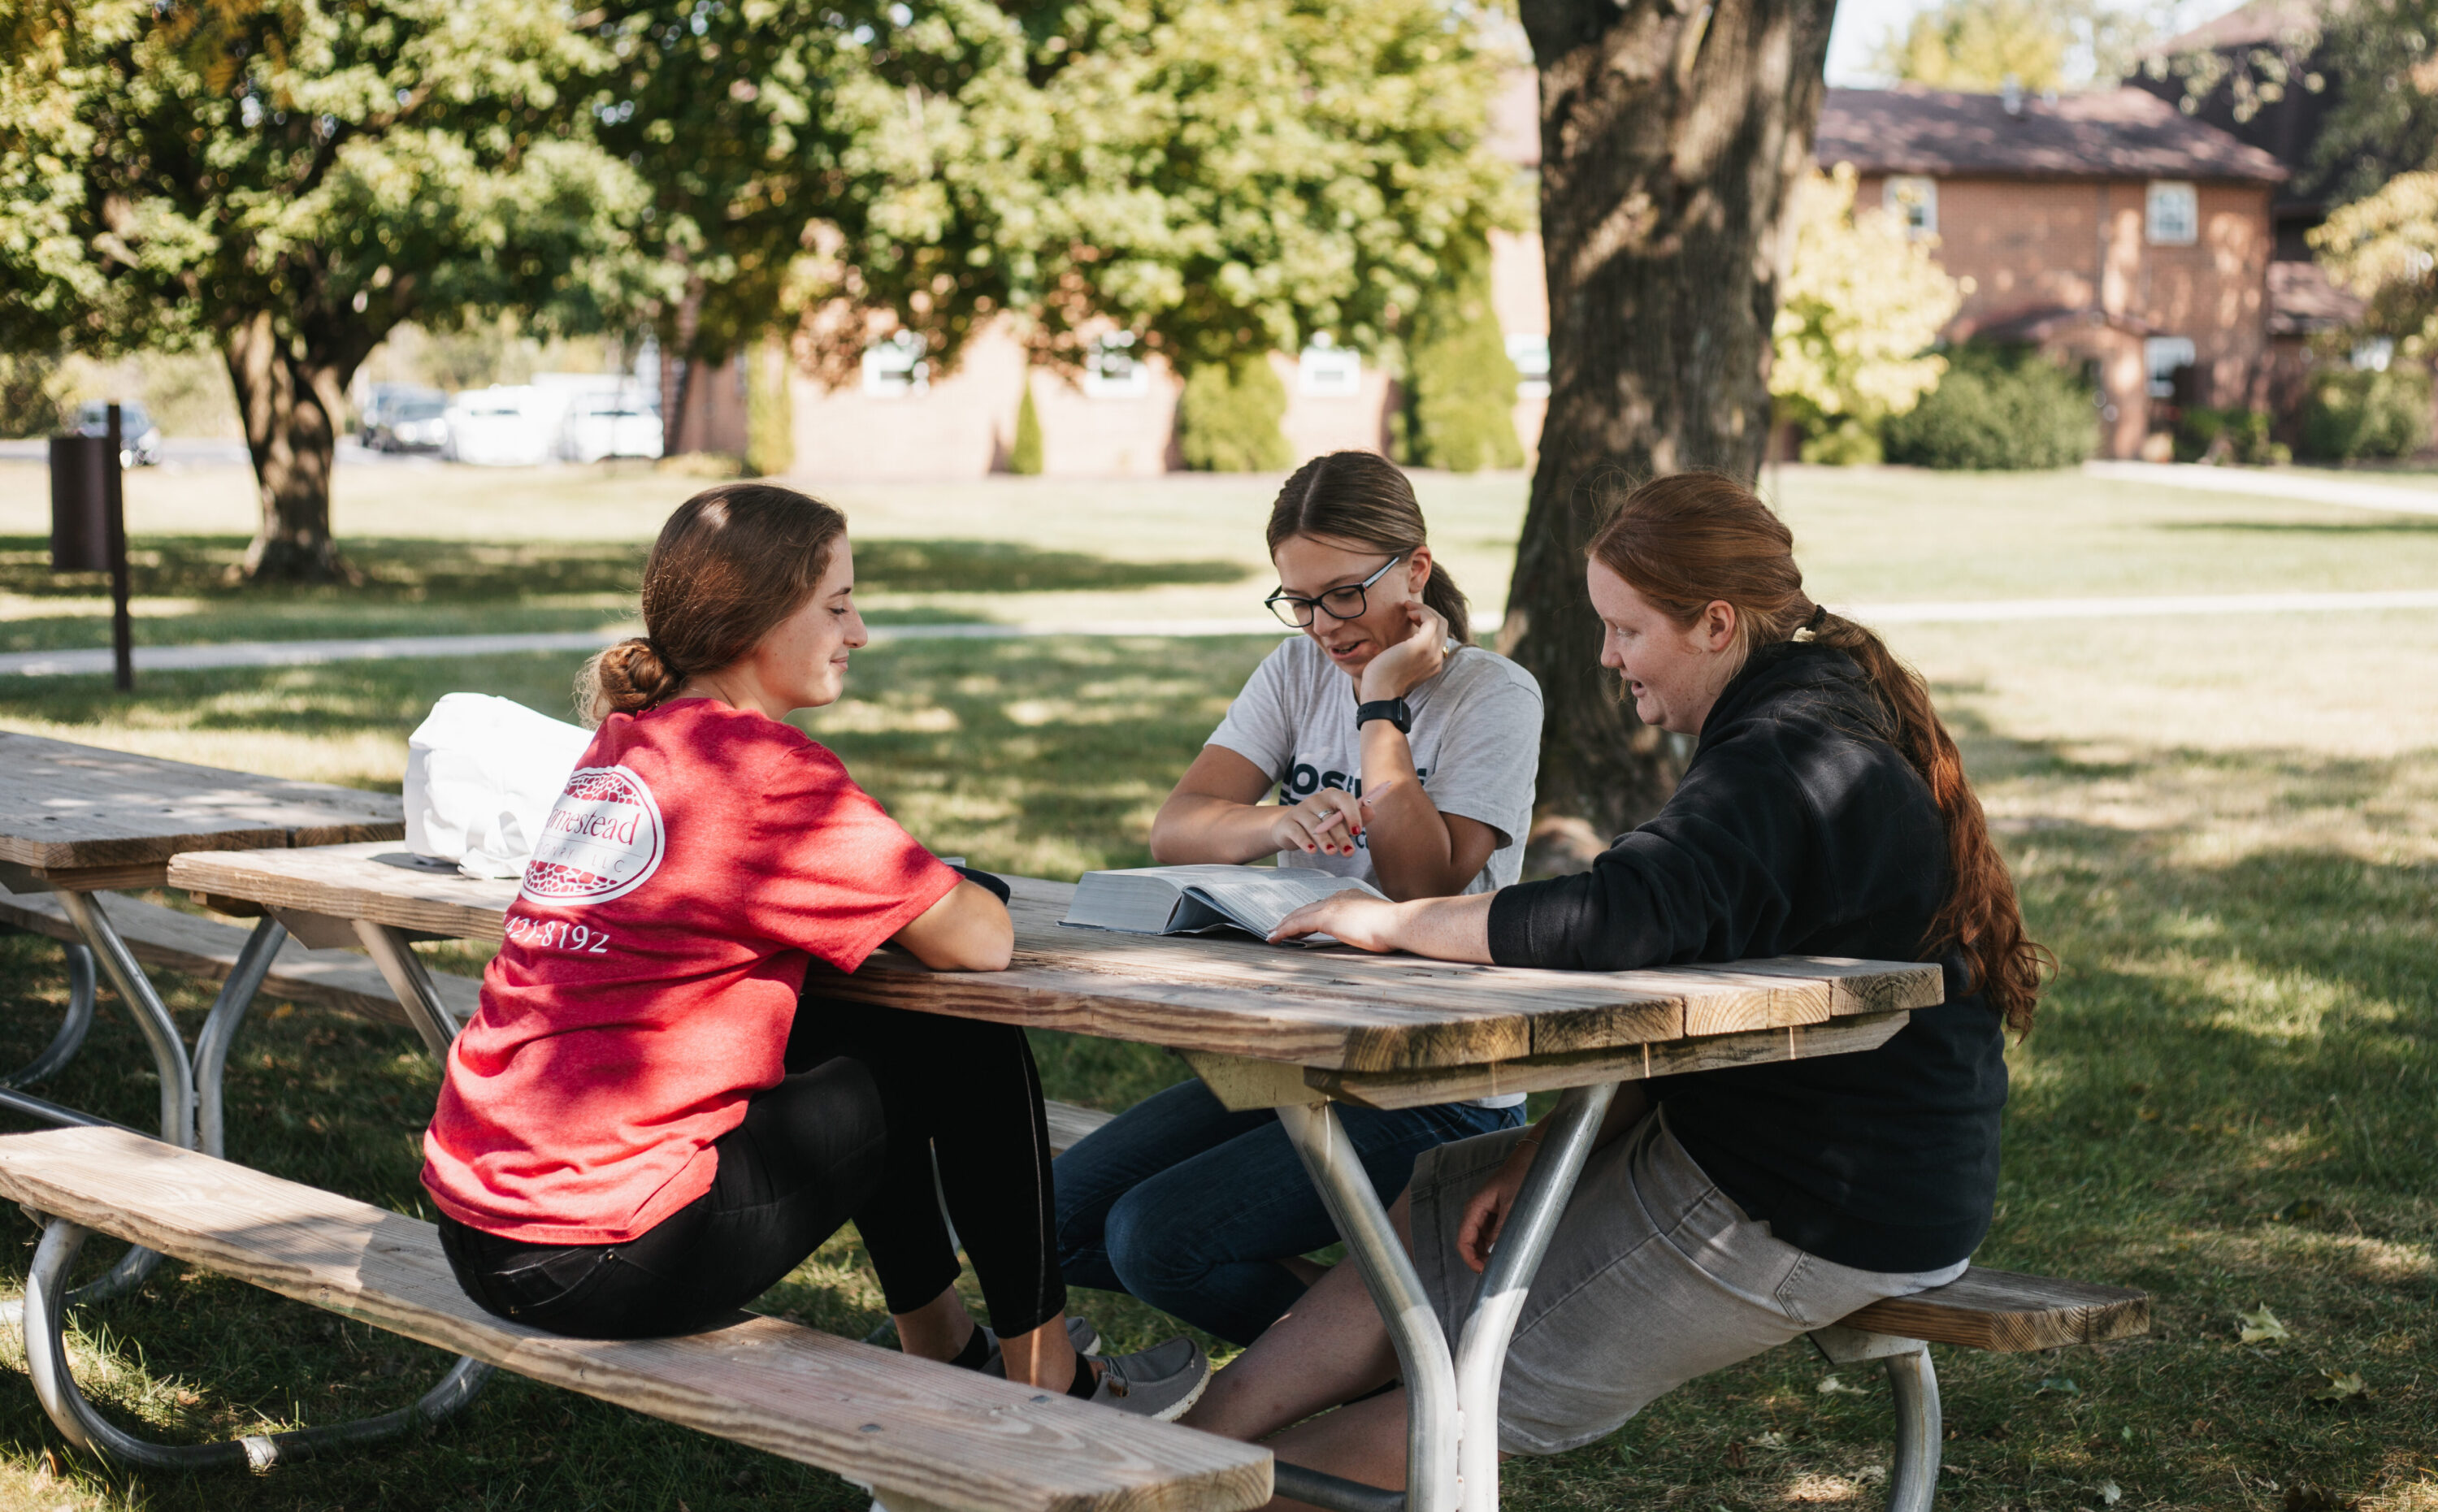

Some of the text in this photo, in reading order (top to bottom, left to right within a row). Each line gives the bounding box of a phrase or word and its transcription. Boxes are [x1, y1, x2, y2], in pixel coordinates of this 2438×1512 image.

[546, 808, 640, 846] omestead
[591, 853, 625, 873] LLC
[502, 914, 610, 954] 421-8192
